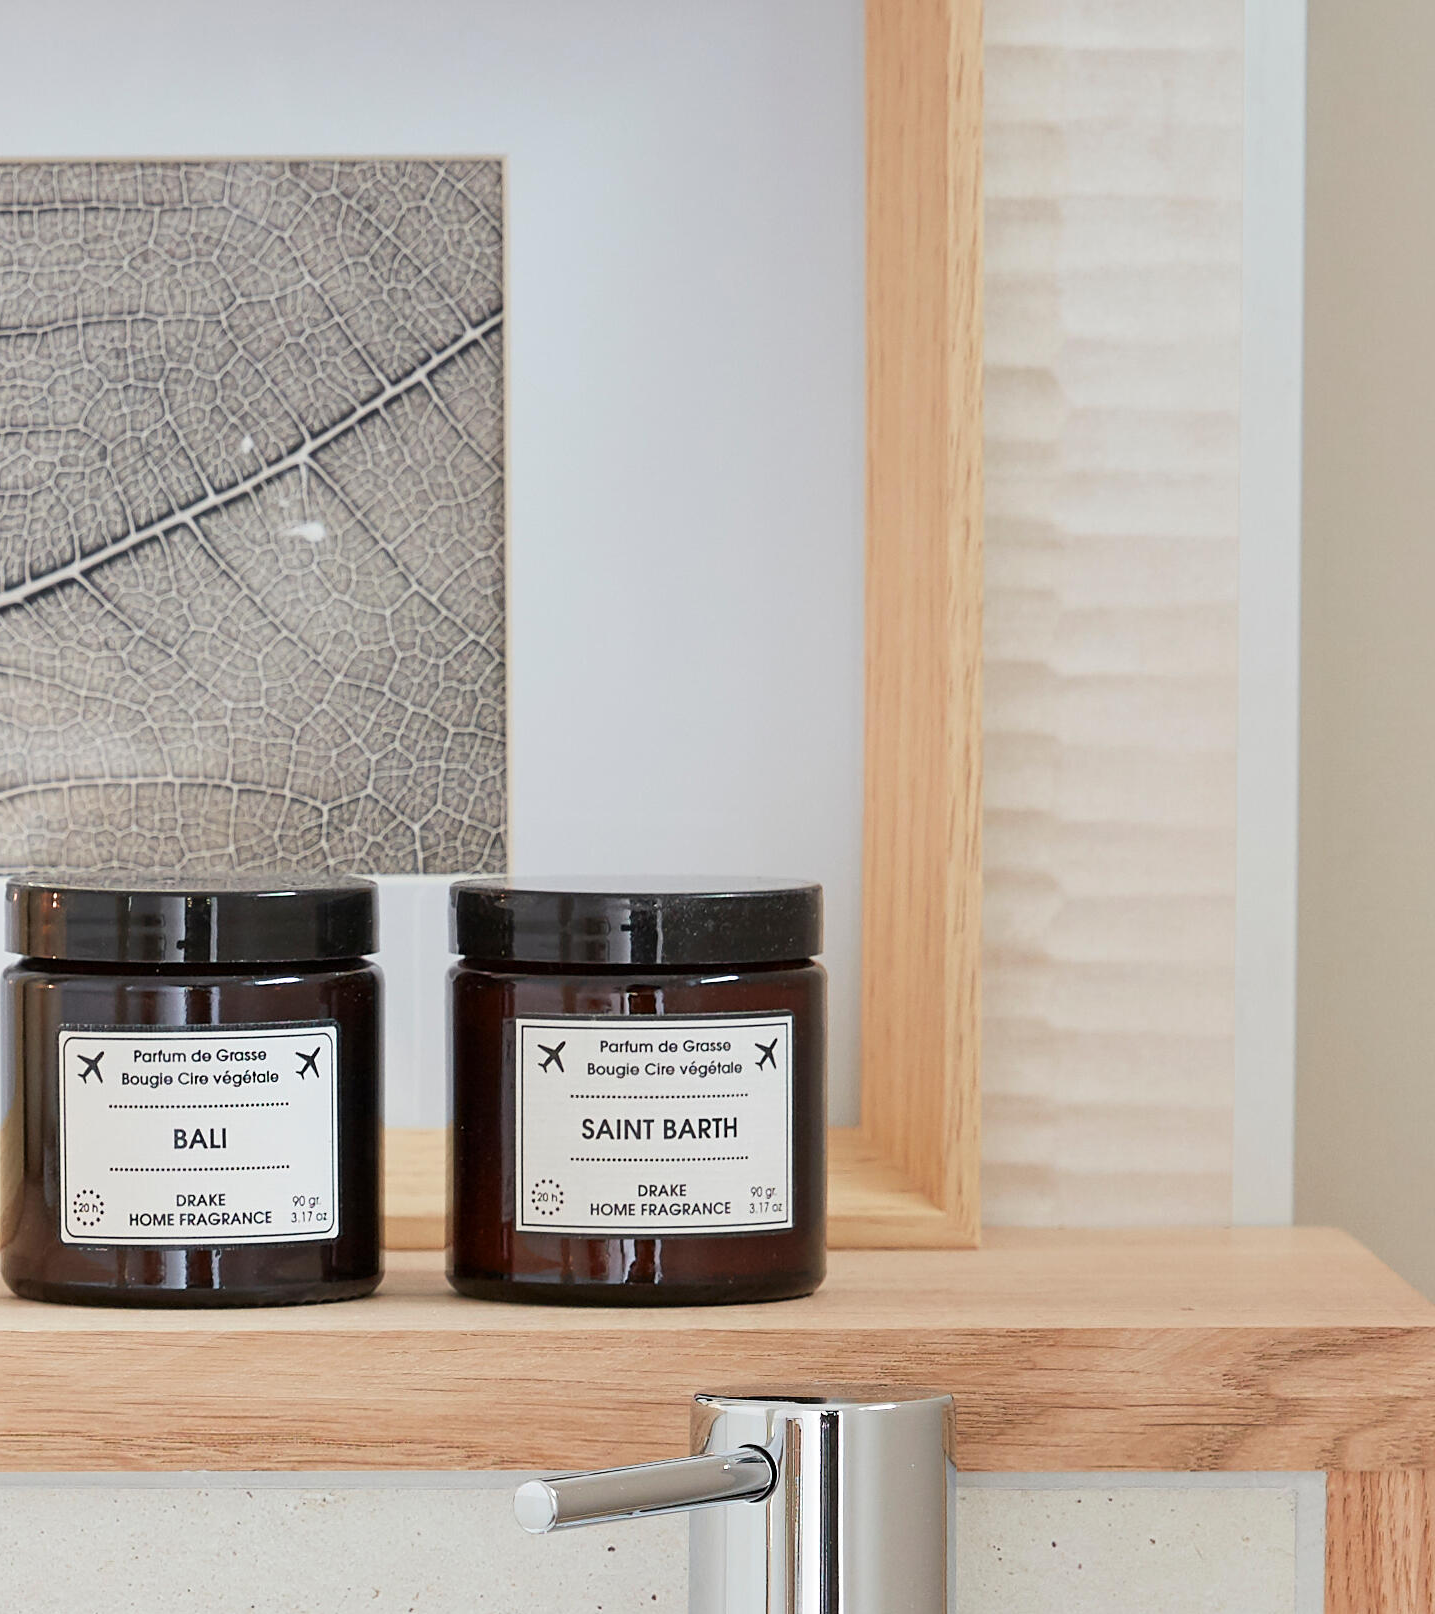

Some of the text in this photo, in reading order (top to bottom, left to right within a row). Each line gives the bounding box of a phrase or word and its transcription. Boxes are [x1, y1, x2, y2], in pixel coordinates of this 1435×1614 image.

[600, 1039, 732, 1054] Parfum de Grasse
[133, 1048, 267, 1063] Parfum de Grasse
[587, 1060, 743, 1080] Bougie Cire végétale
[121, 1069, 279, 1089] Bougie Cire végétale
[581, 1116, 738, 1141] SAINT BARTH
[173, 1127, 227, 1150] BALI
[536, 1191, 558, 1203] 20 h
[637, 1183, 687, 1198] DRAKE
[750, 1185, 763, 1198] 90
[78, 1202, 99, 1213] 20 h
[176, 1193, 226, 1207] DRAKE
[292, 1195, 306, 1207] 90
[590, 1201, 732, 1217] HOME FRAGRANCE
[749, 1202, 783, 1214] 3.17 oz
[129, 1210, 272, 1227] HOME FRAGRANCE
[290, 1210, 328, 1224] 3.17 oz
